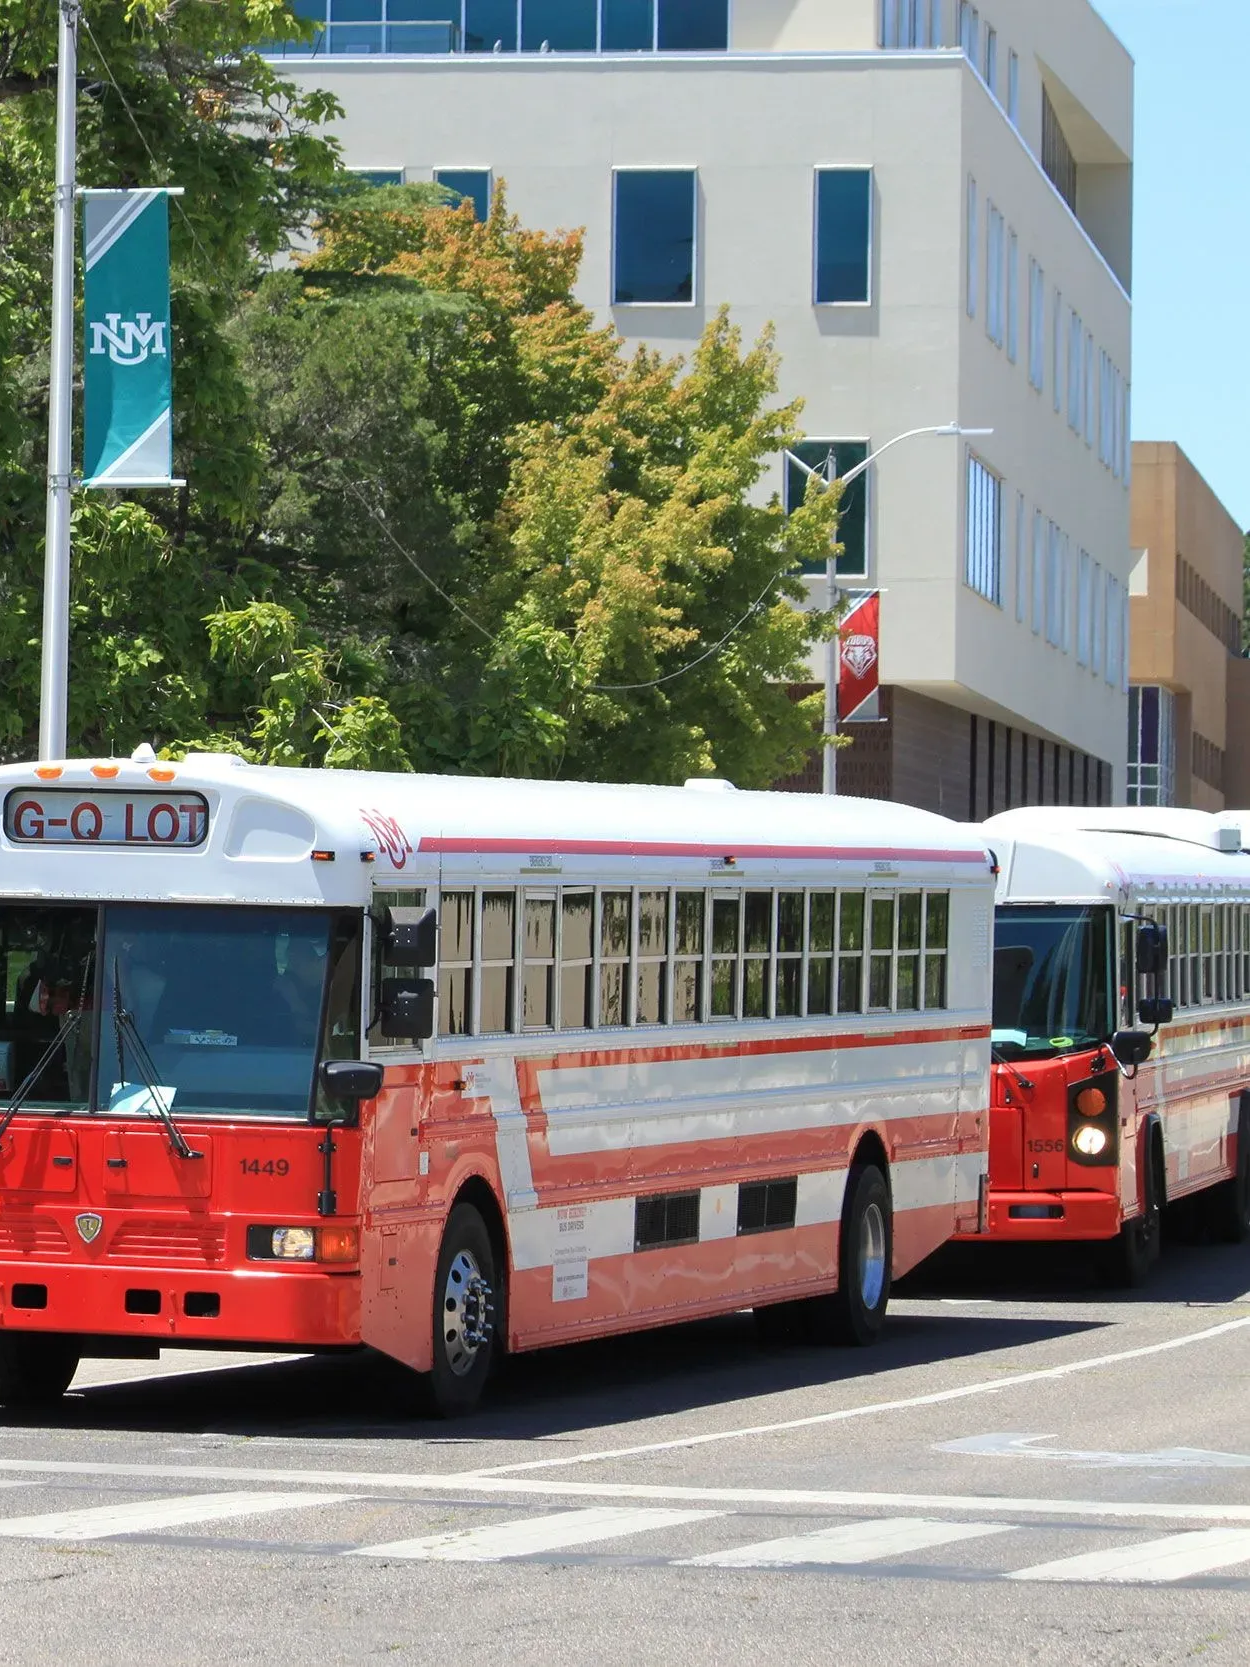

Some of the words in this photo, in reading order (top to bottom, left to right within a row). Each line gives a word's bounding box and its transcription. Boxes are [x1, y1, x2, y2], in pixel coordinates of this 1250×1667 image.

[13, 800, 103, 841] G-Q
[125, 803, 206, 842] LOT
[1027, 1139, 1064, 1153] 1556
[239, 1158, 290, 1177] 1449
